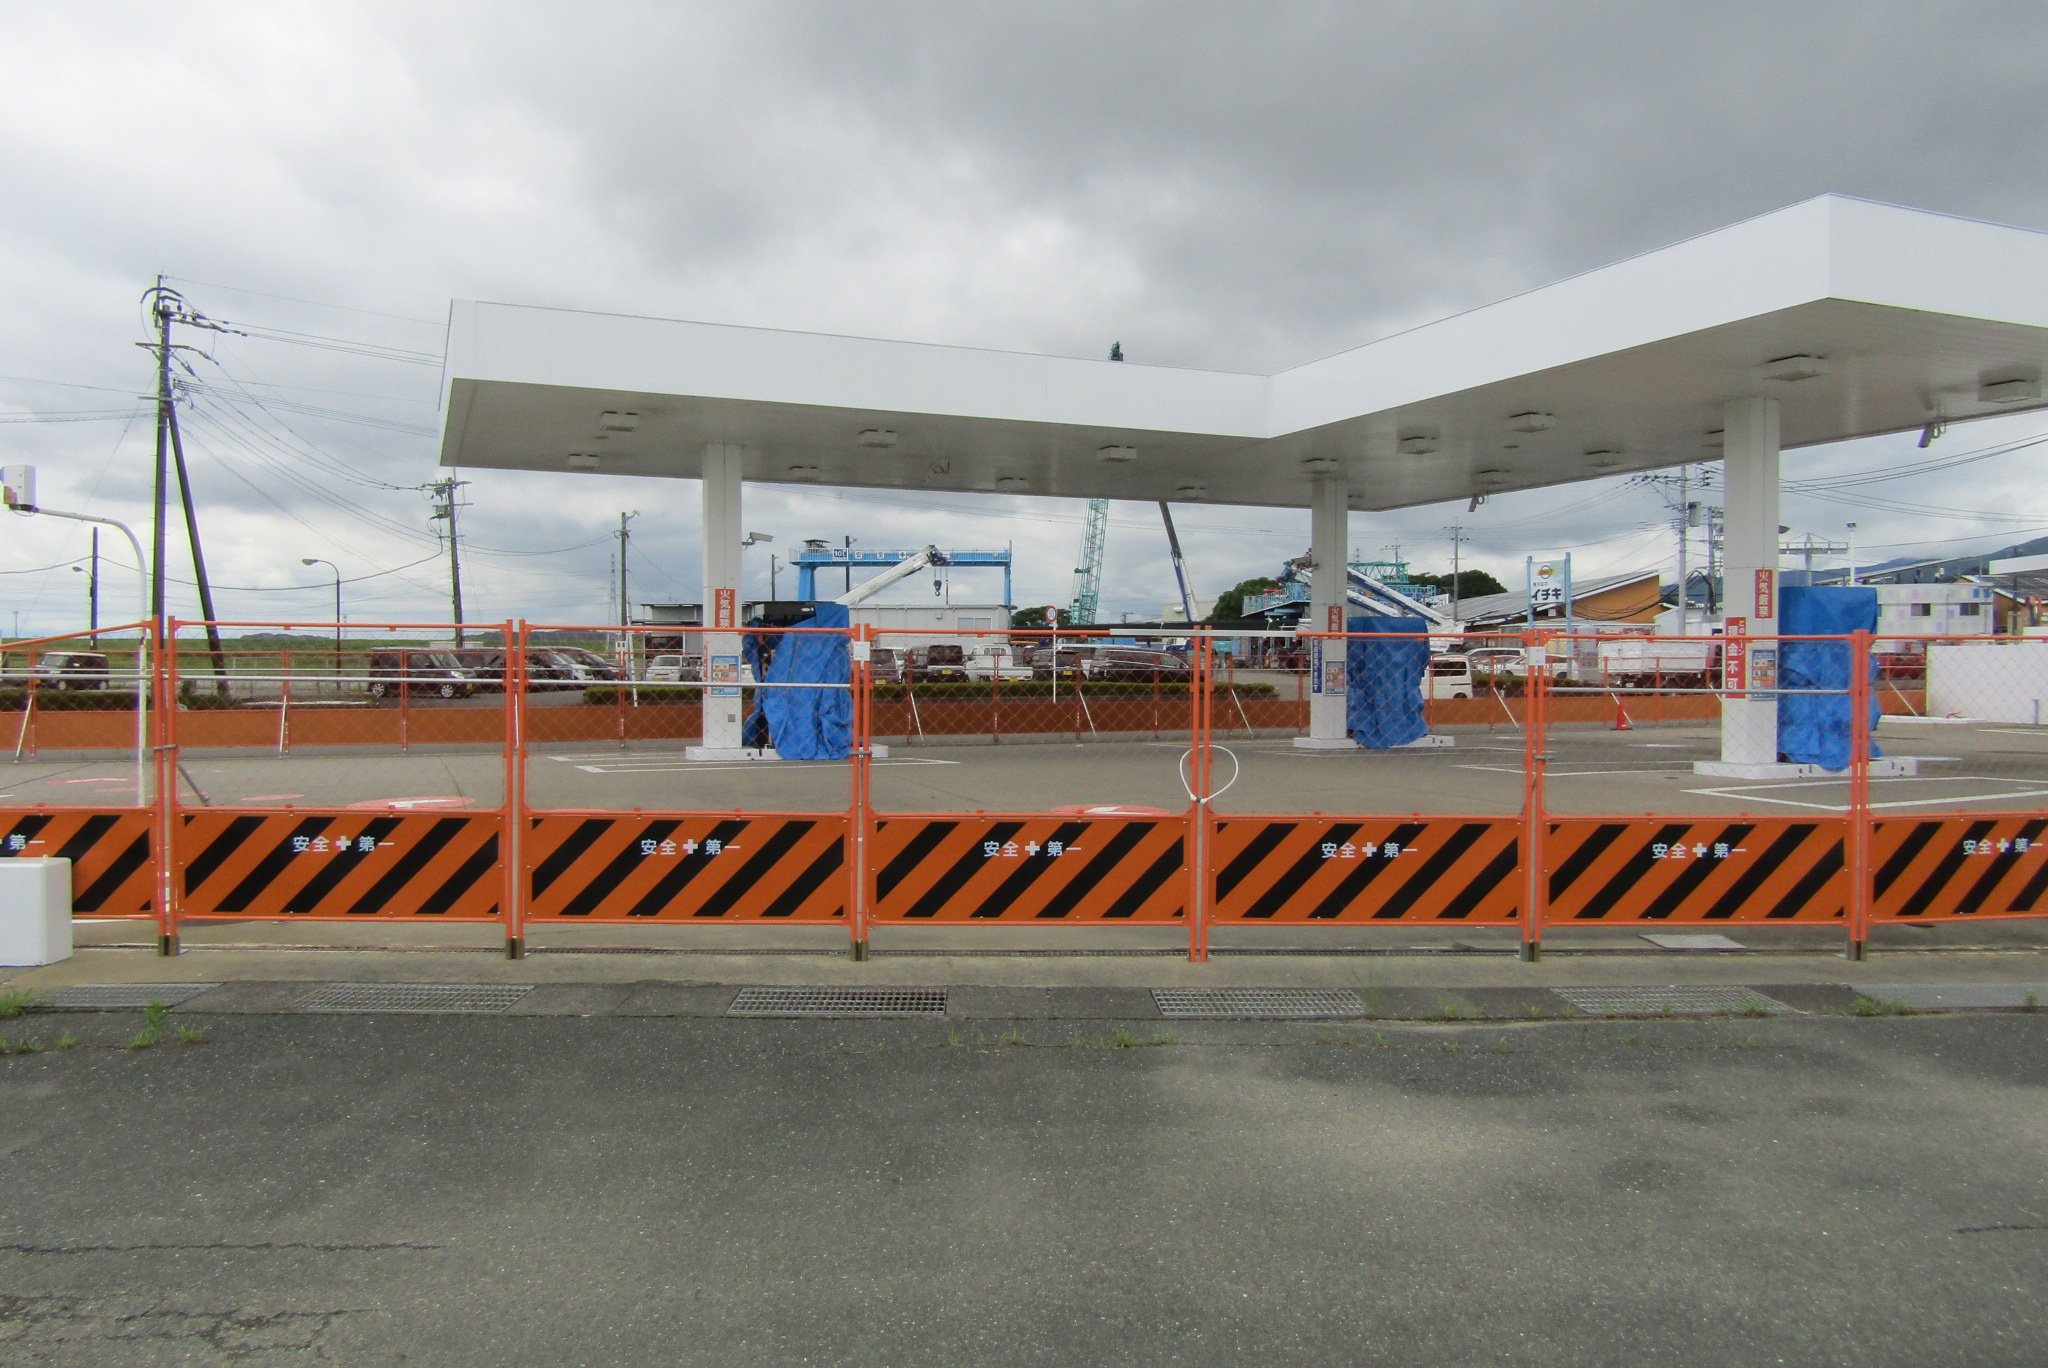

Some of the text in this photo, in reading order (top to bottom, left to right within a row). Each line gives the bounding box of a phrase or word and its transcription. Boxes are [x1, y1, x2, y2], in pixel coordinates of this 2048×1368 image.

[1532, 587, 1561, 601] イチキ
[1759, 571, 1769, 617] 火気厳禁
[9, 834, 46, 850] 第一
[293, 836, 395, 852] 安全 第一
[641, 839, 741, 855] 安全 第一
[984, 841, 1082, 857] 安全 第一
[1321, 842, 1418, 858] 安全 第一
[1963, 838, 2043, 855] 安全 第一
[1652, 843, 1747, 859] 安全 第一
